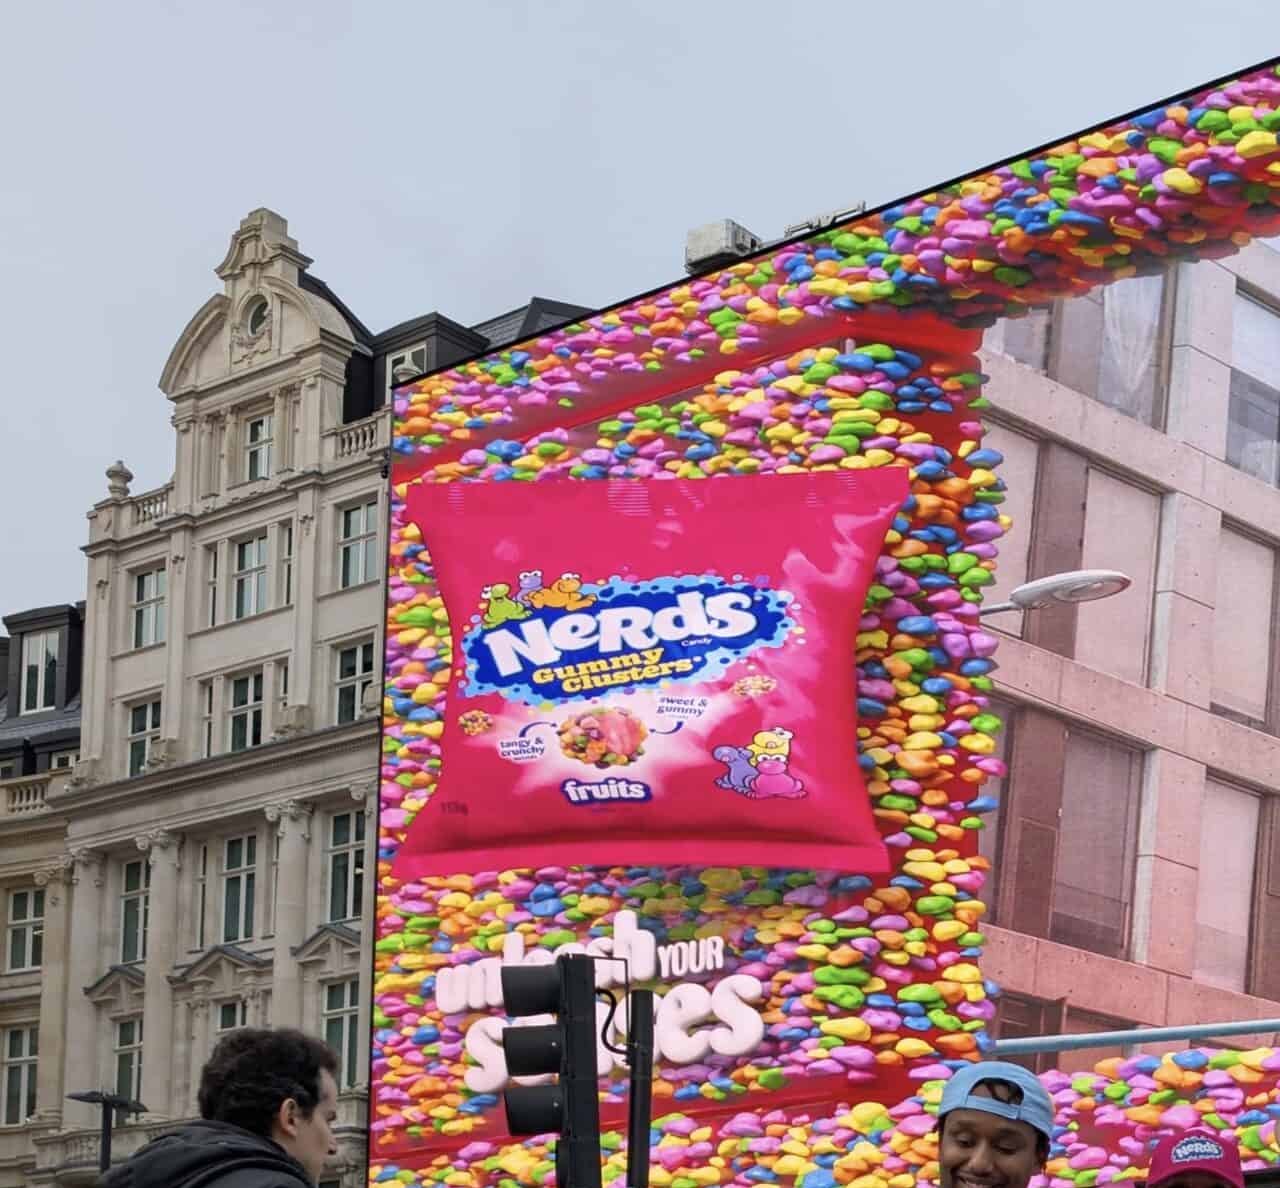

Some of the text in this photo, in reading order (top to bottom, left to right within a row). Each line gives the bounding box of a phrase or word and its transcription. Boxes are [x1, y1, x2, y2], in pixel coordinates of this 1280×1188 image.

[531, 648, 666, 685] Gummy
[562, 658, 694, 693] Clusters
[656, 705, 705, 717] gummy
[500, 739, 532, 750] tangy
[501, 746, 546, 757] crunchy
[563, 779, 646, 801] fruits
[656, 936, 725, 978] YOUR
